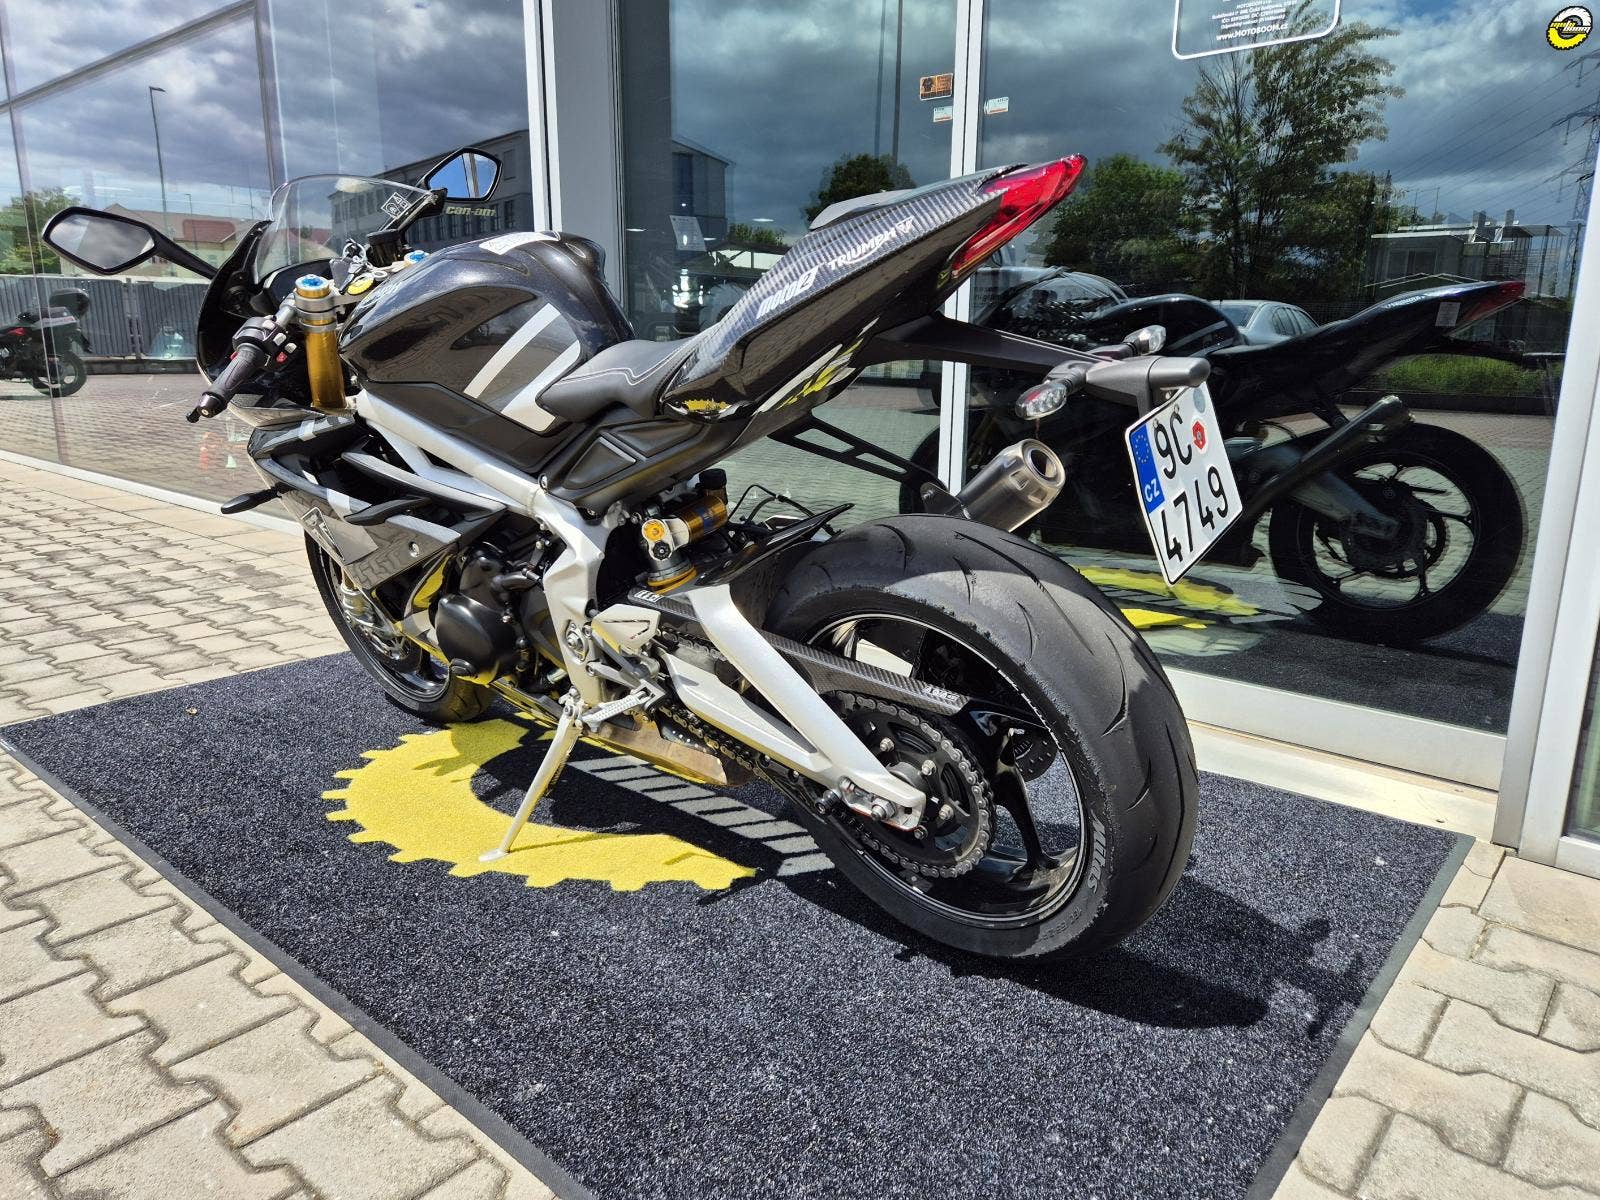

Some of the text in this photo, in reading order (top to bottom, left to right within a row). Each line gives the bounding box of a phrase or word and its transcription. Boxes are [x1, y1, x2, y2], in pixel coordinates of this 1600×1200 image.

[1216, 23, 1288, 41] www.MOTOBOOM.cz
[828, 227, 896, 270] TRIUMPH
[1154, 410, 1192, 479] 9C
[1144, 478, 1160, 502] CZ
[1161, 466, 1228, 562] 4749
